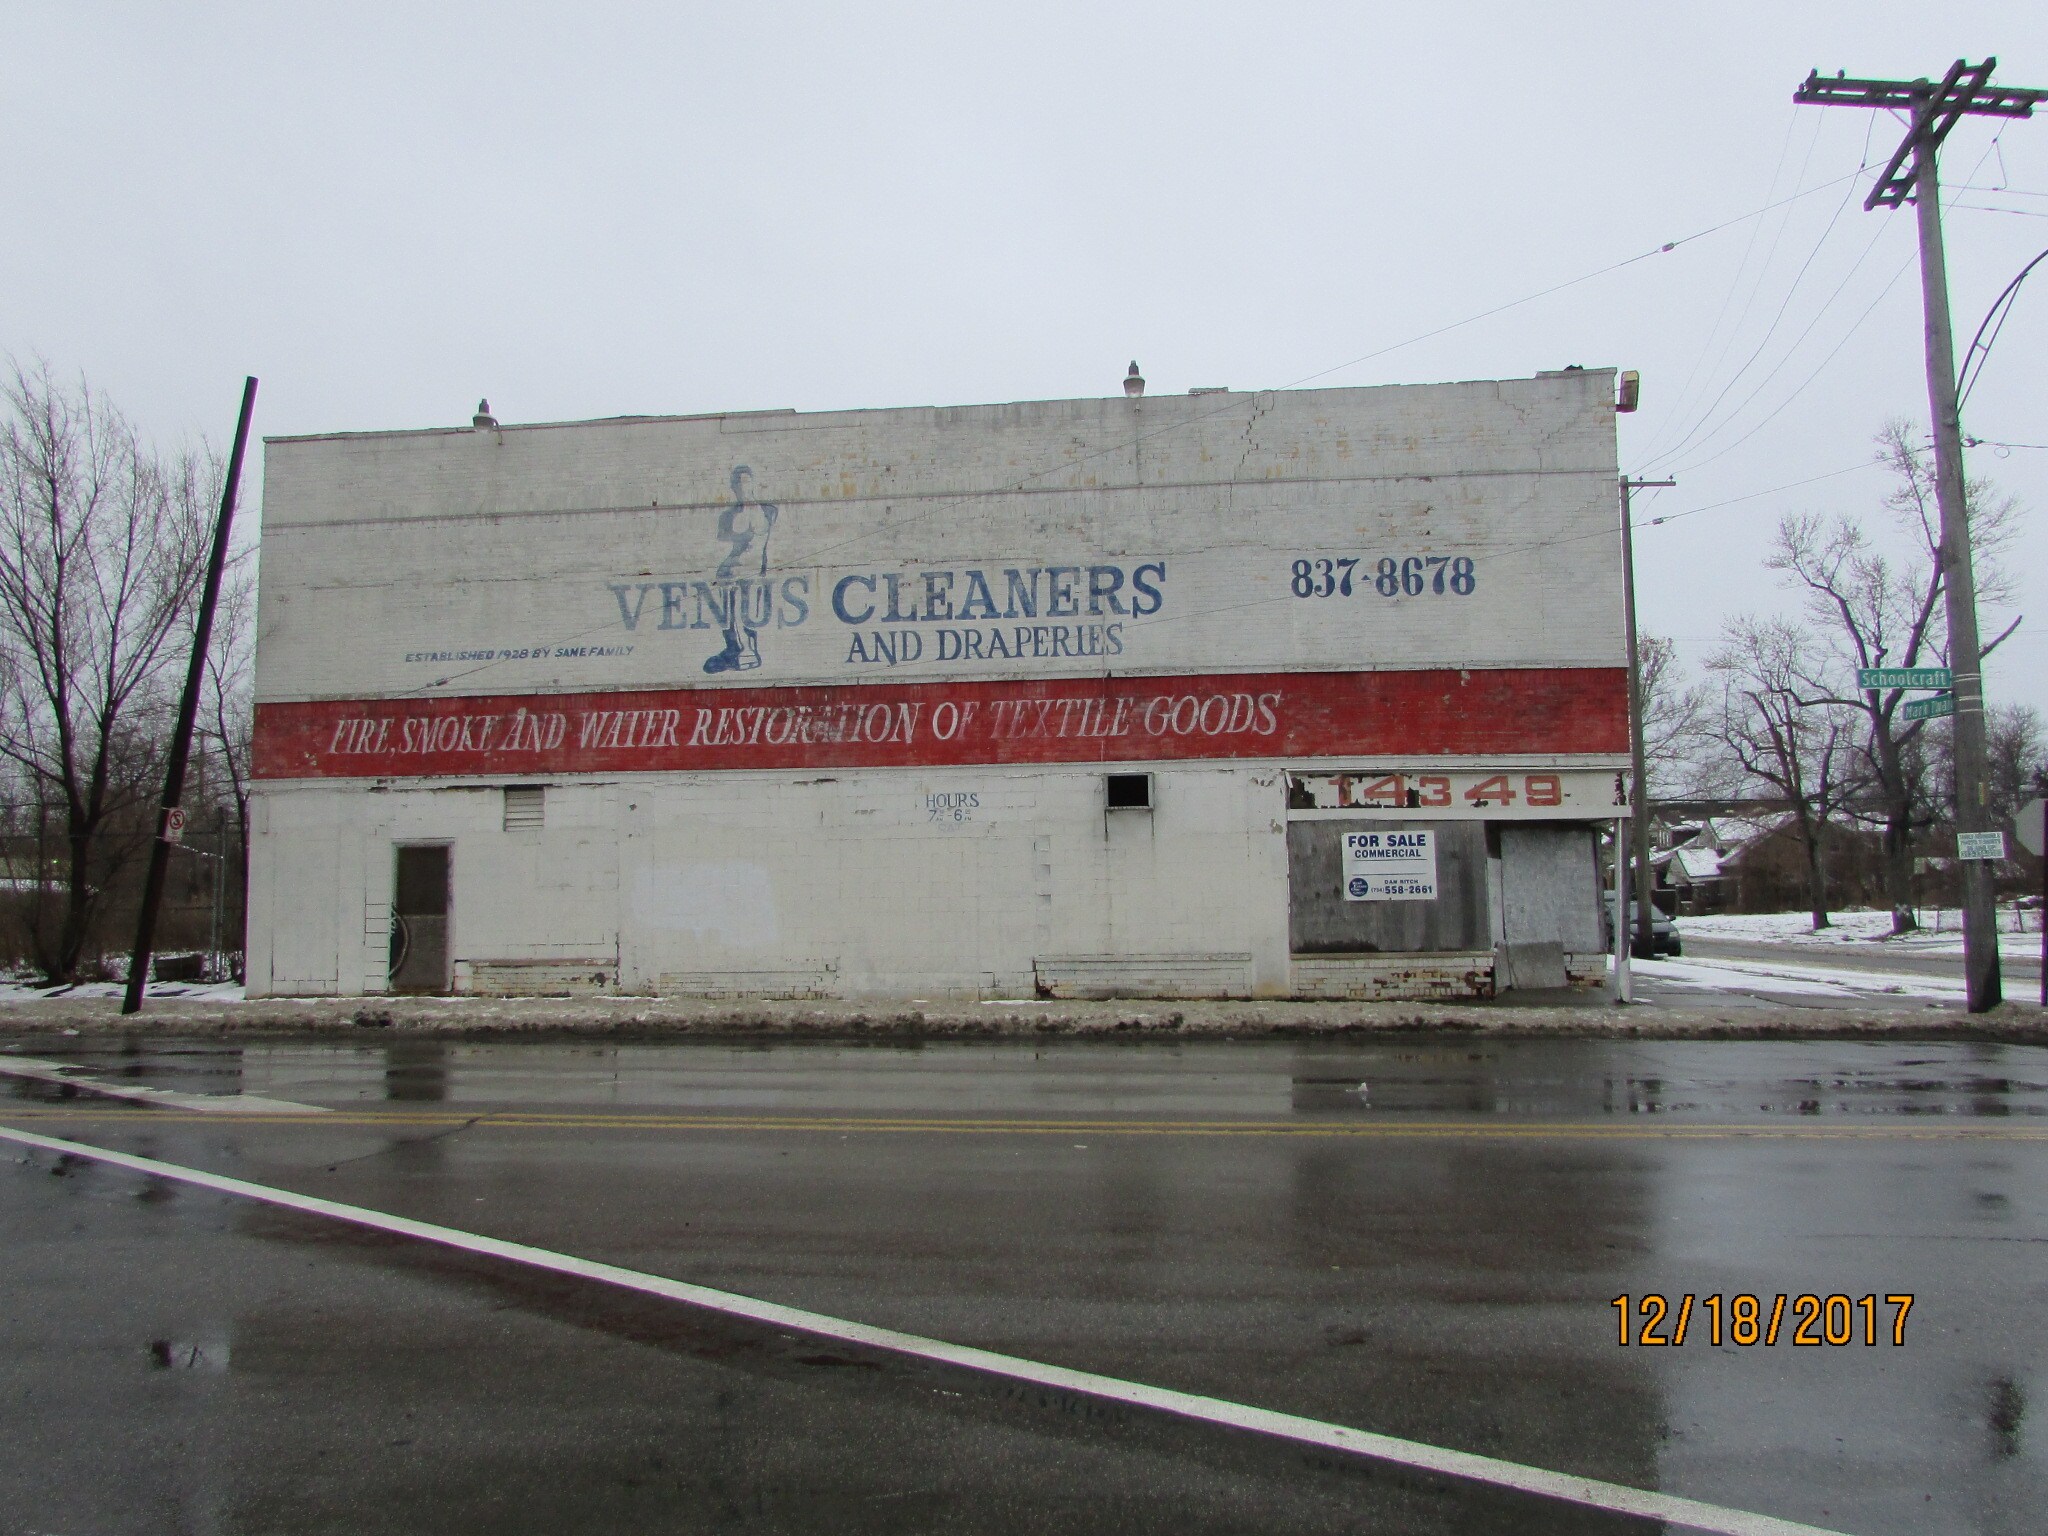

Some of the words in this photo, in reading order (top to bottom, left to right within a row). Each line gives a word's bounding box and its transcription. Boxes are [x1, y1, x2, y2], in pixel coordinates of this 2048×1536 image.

[1291, 556, 1475, 599] 837-8678
[607, 576, 809, 630] VENUS
[832, 562, 1166, 625] CLEANERS
[405, 651, 495, 662] ESTABLISHED
[496, 649, 529, 660] 1928
[531, 648, 550, 659] BY
[554, 647, 587, 658] SAME
[587, 646, 634, 657] FAMILY
[845, 629, 923, 666] AND
[935, 622, 1124, 661] DRAPERIES
[1862, 671, 1947, 687] Schoolcraft
[400, 714, 500, 753] SMOKE
[501, 709, 567, 753] AND
[579, 708, 681, 749] WATER
[688, 702, 926, 746] RESTORATION
[932, 701, 979, 741] OF
[990, 696, 1134, 739] TEXTILE
[1144, 690, 1284, 736] GOODS
[926, 792, 980, 808] HOURS
[1328, 774, 1562, 807] 14349
[1348, 835, 1379, 847] FOR
[1387, 834, 1426, 847] SALE
[1354, 849, 1421, 858] COMMERCIAL
